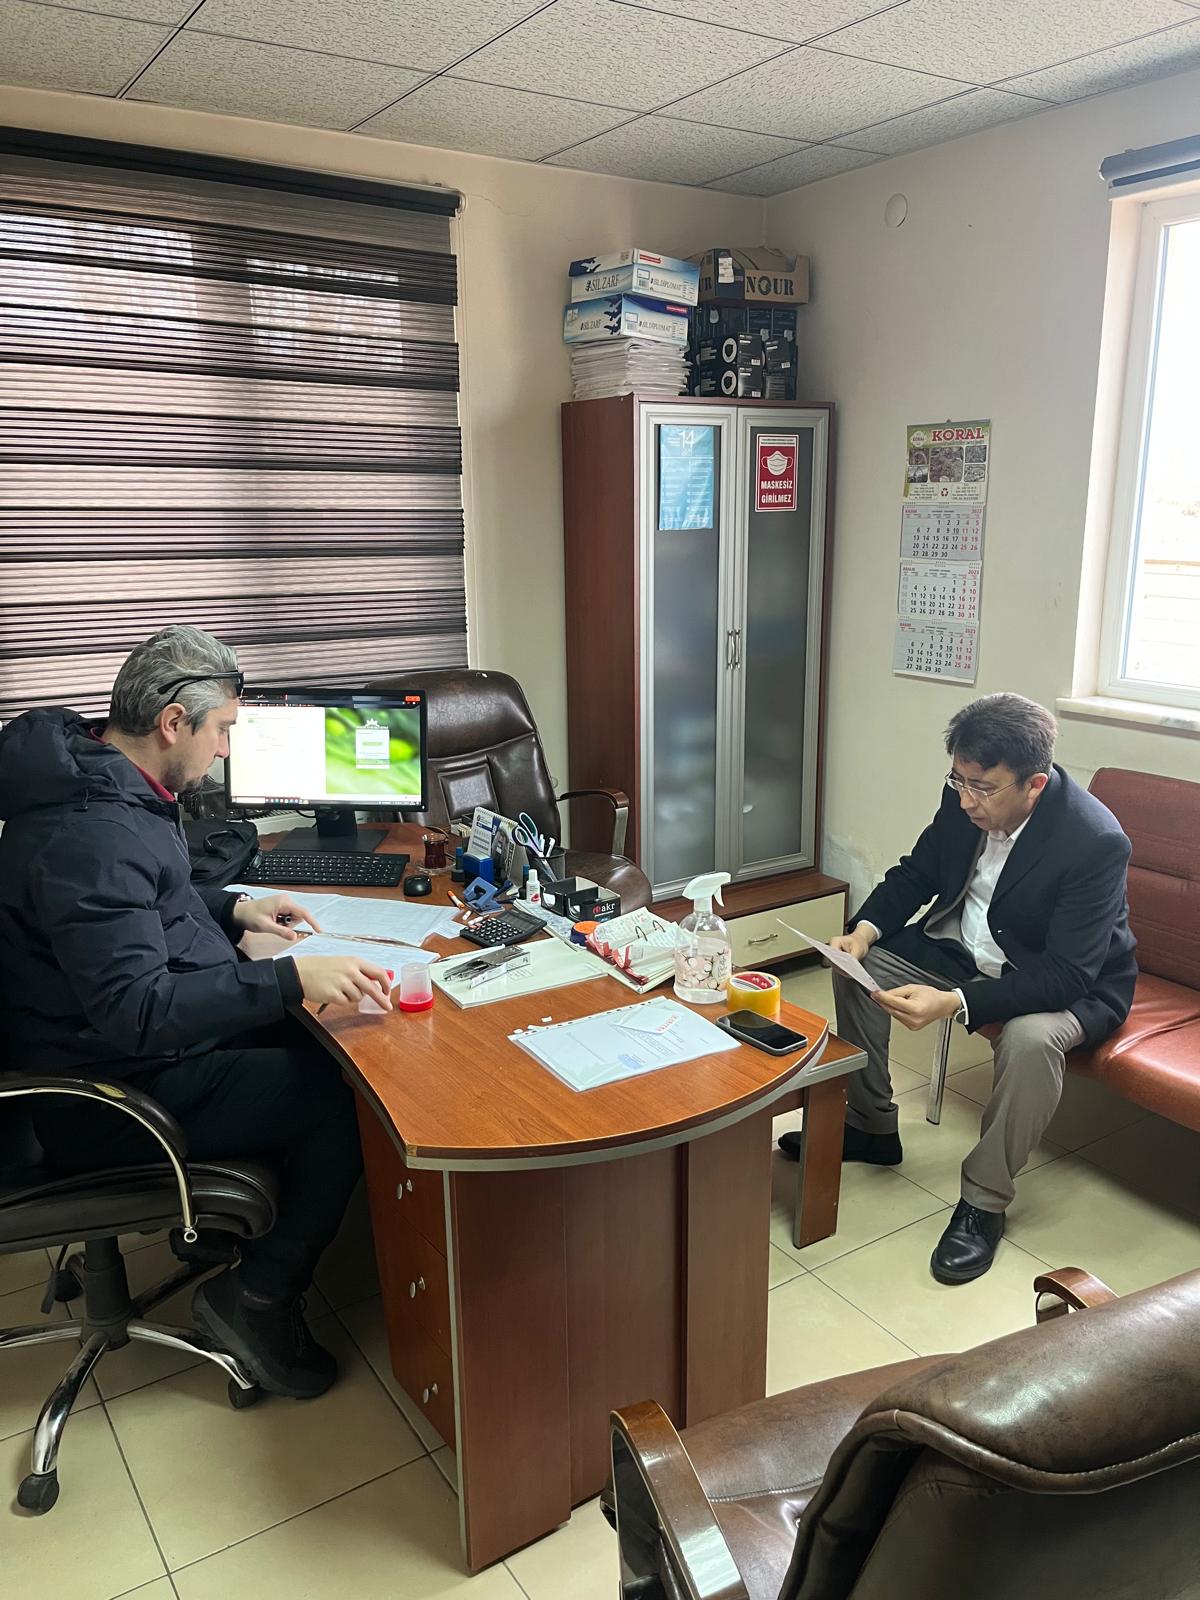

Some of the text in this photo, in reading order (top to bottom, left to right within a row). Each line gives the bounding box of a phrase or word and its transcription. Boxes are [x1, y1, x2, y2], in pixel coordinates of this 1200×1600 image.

[746, 275, 795, 297] NOUR
[932, 428, 985, 442] KORAL
[761, 478, 793, 490] MASKESİZ
[761, 493, 792, 504] GİRİLMEZ
